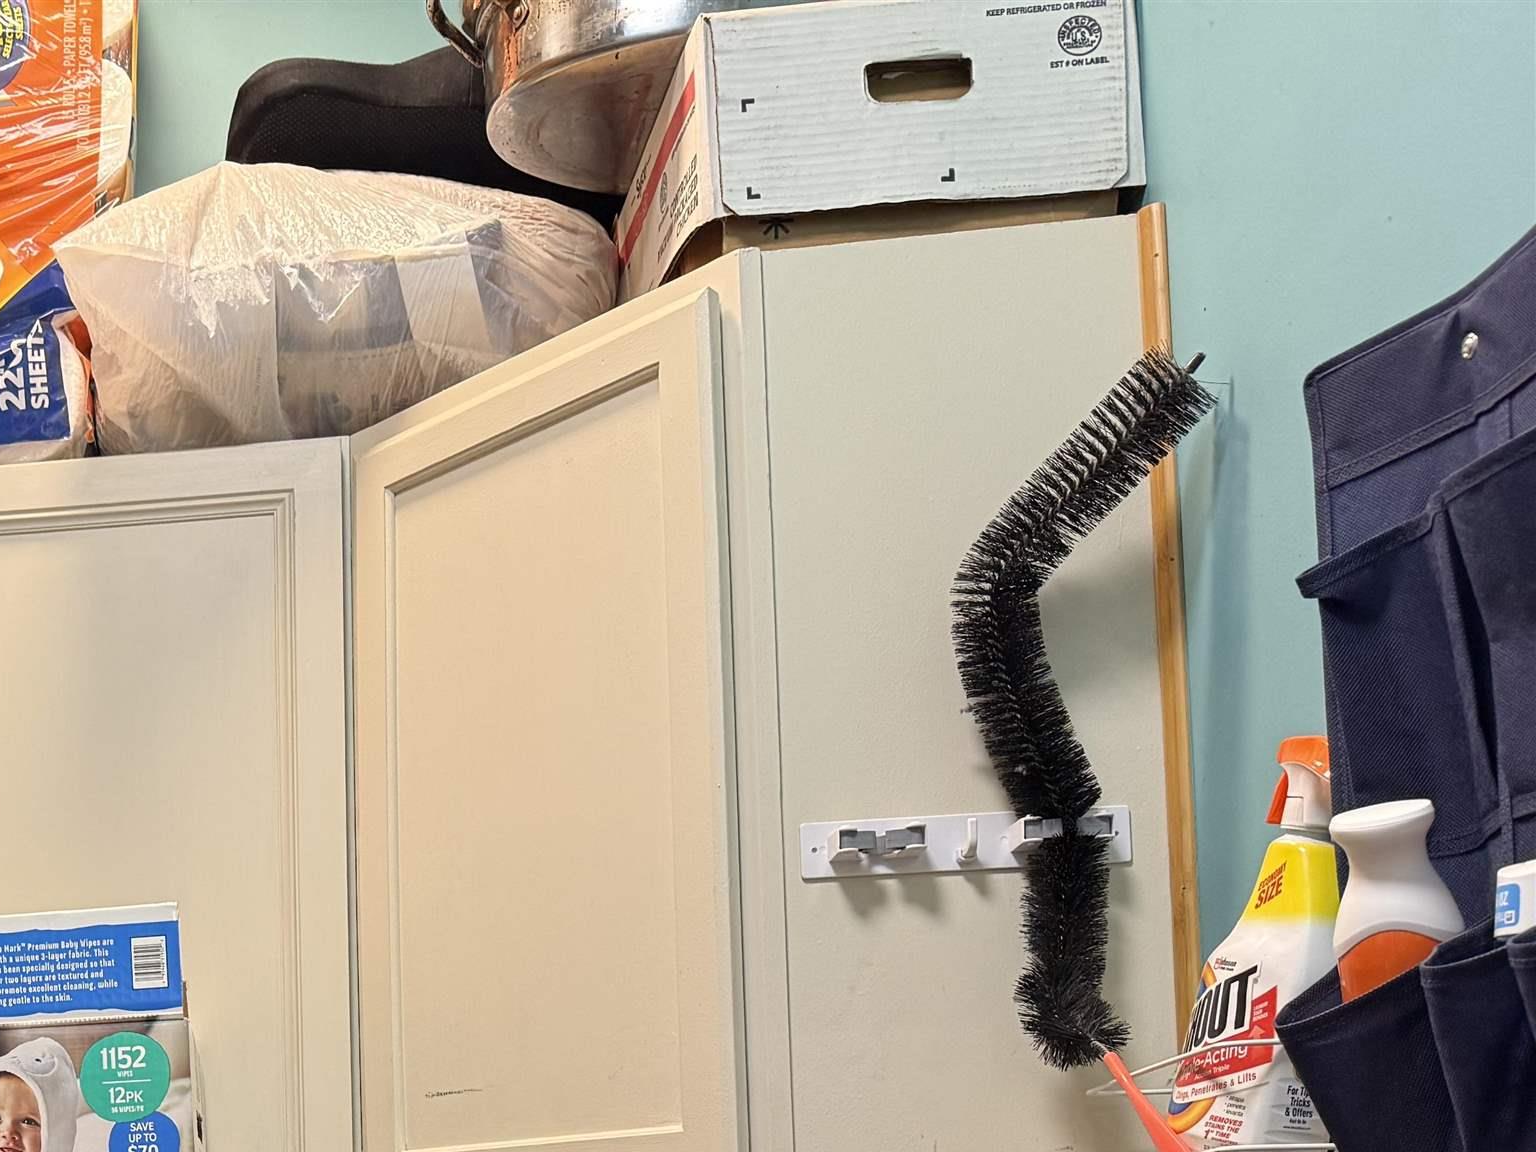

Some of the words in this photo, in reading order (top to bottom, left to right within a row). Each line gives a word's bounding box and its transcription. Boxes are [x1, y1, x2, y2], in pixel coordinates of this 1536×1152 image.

[986, 9, 1005, 17] KEEP
[1006, 3, 1062, 16] REFRIGERATED
[1063, 2, 1075, 10] OR
[1075, 0, 1107, 9] FROZEN
[1050, 60, 1064, 69] EST
[1071, 59, 1084, 67] ON
[1085, 56, 1110, 65] LABEL
[1257, 859, 1288, 892] ECONOMY
[1254, 875, 1284, 910] SIZE
[27, 941, 60, 951] Premium
[60, 940, 79, 951] Baby
[79, 938, 101, 949] Wipes
[15, 954, 39, 964] unique
[40, 951, 67, 962] 3-layer
[22, 962, 55, 974] specially
[56, 960, 89, 972] designed
[20, 974, 43, 985] layers
[57, 970, 89, 980] textured
[28, 982, 62, 993] excellent
[97, 979, 119, 989] while
[8, 995, 31, 1007] gentle
[100, 1045, 147, 1070] 1152
[1190, 1080, 1228, 1097] Penetrates
[1236, 1072, 1257, 1085] Lifts
[1287, 1085, 1299, 1096] For
[108, 1086, 144, 1105] 12PK
[1290, 1098, 1311, 1108] Tricks
[1291, 1107, 1313, 1119] Offers
[130, 1121, 155, 1132] SAVE
[1204, 1121, 1226, 1132] STAINS
[1208, 1114, 1244, 1127] REMOVES
[128, 1133, 142, 1143] UP
[143, 1132, 157, 1142] TO
